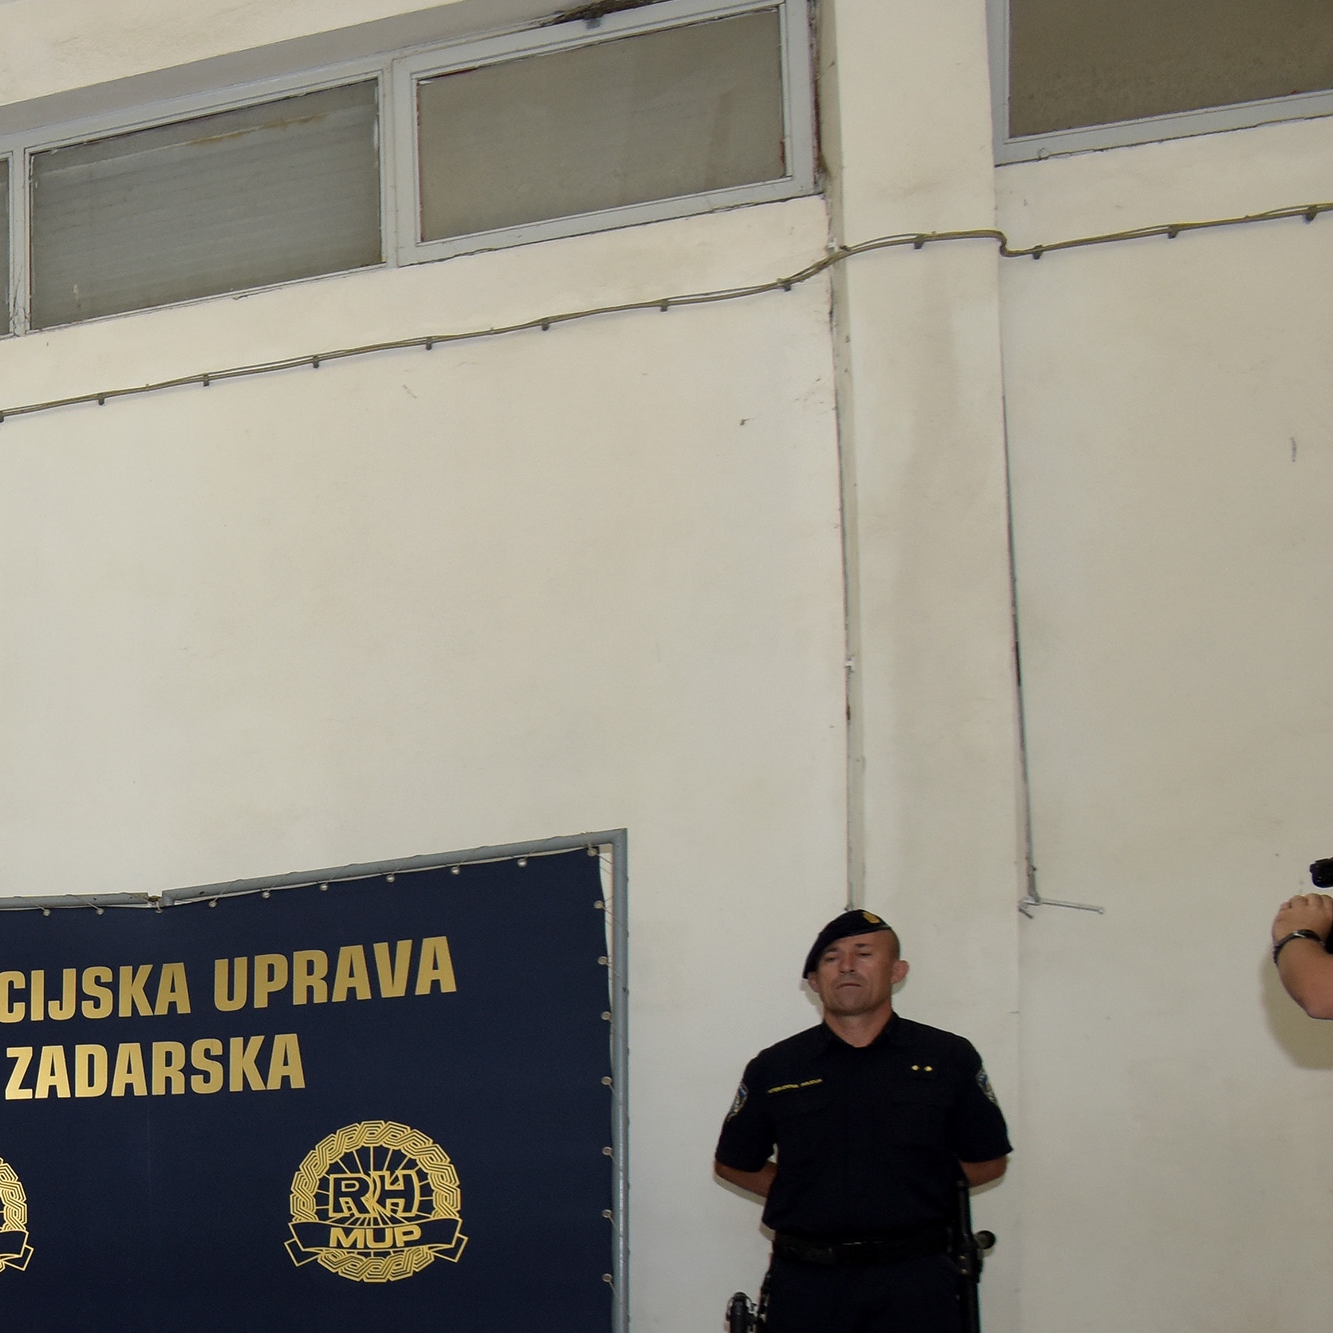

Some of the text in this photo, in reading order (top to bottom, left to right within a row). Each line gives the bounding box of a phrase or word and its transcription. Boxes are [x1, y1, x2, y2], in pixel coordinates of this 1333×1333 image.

[215, 937, 457, 1011] UPRAVA
[5, 1034, 305, 1100] ZADARSKA
[329, 1170, 419, 1219] RH
[329, 1223, 422, 1249] MUP
